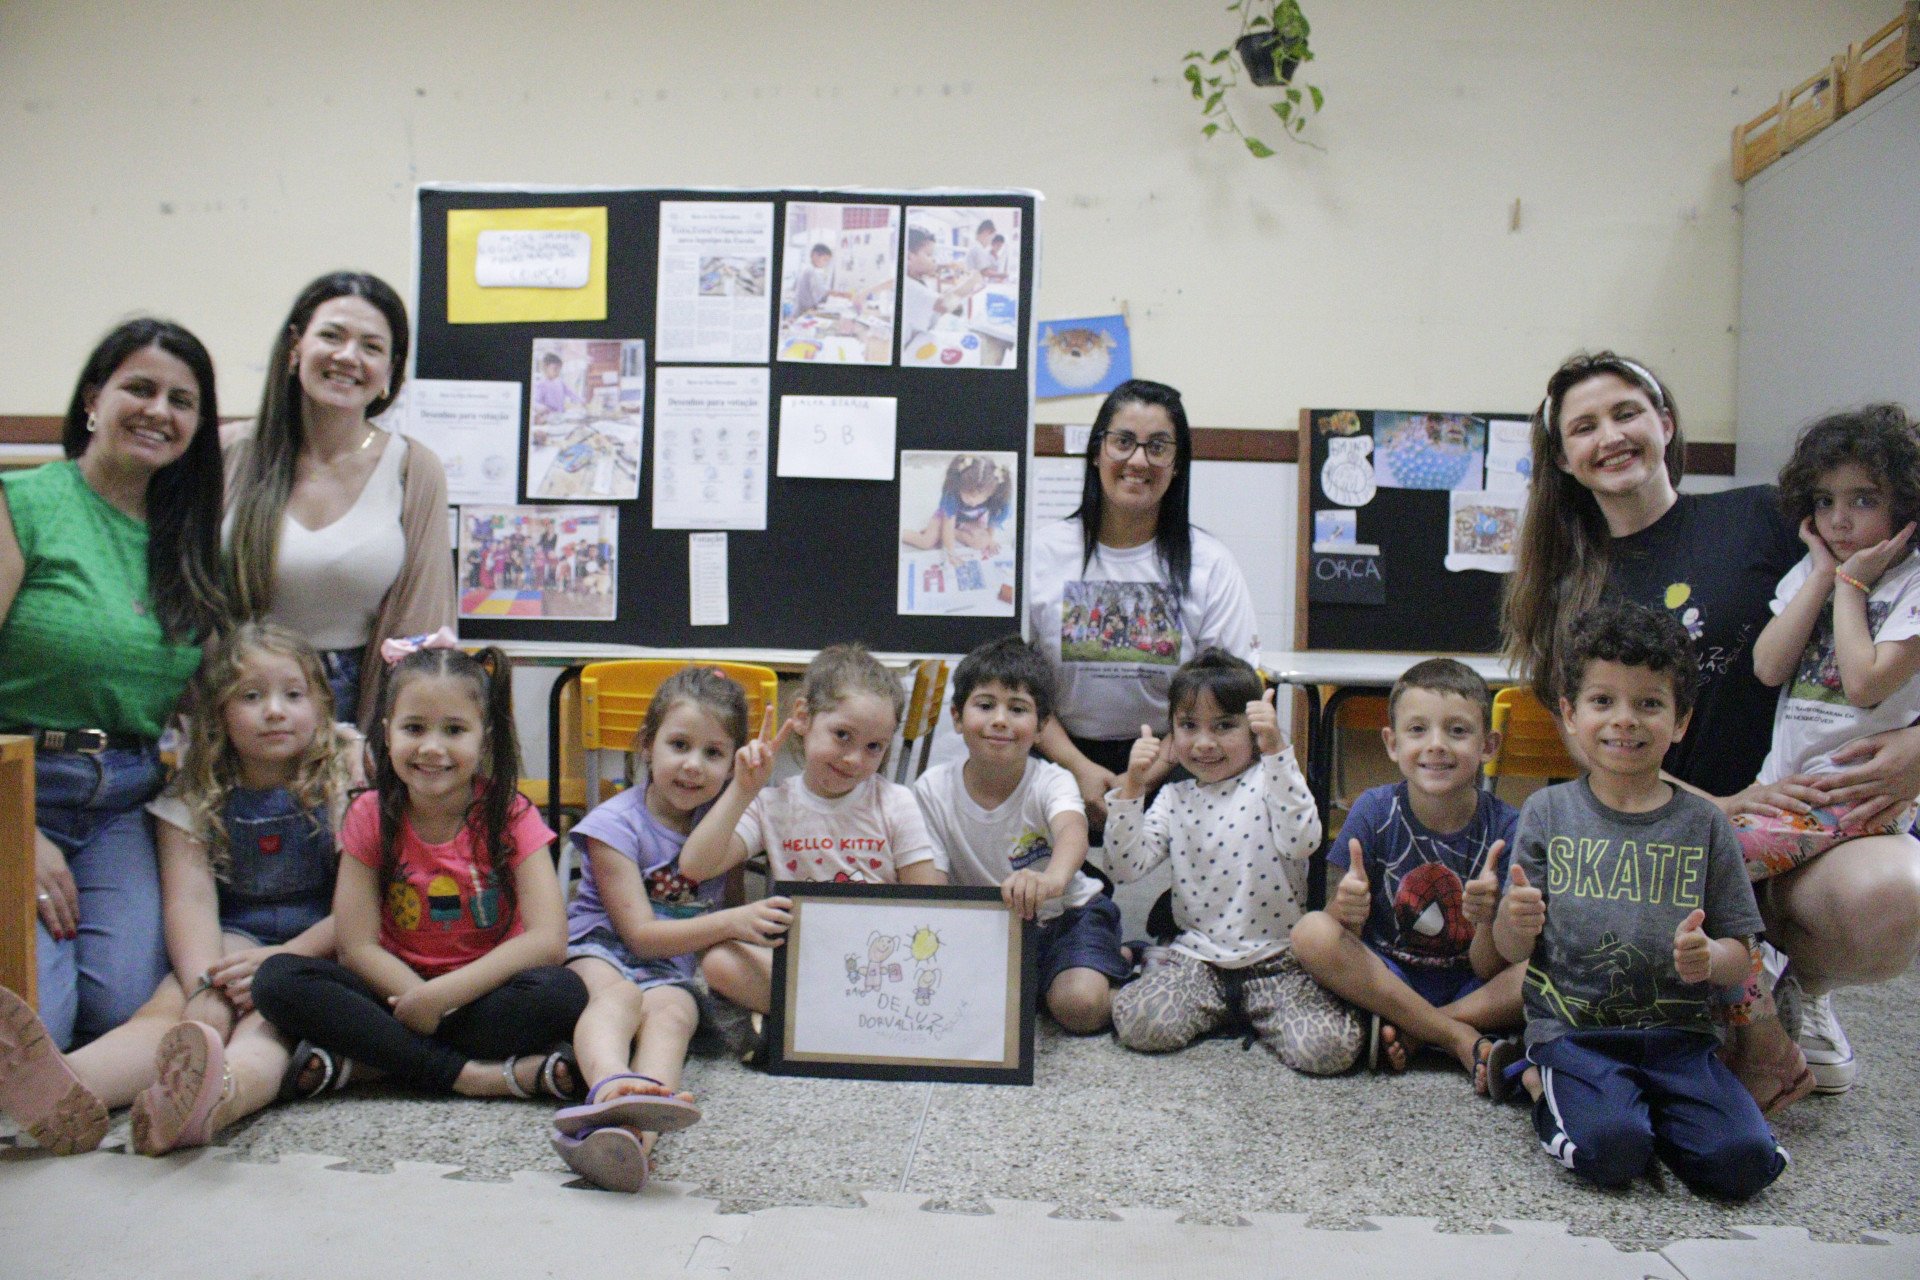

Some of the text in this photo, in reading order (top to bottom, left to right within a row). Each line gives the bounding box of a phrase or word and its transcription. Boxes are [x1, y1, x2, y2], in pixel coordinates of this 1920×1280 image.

[1315, 557, 1382, 581] ORCA
[783, 837, 886, 852] HELLO KITTY
[1548, 836, 1704, 907] SKATE
[877, 993, 900, 1013] DE
